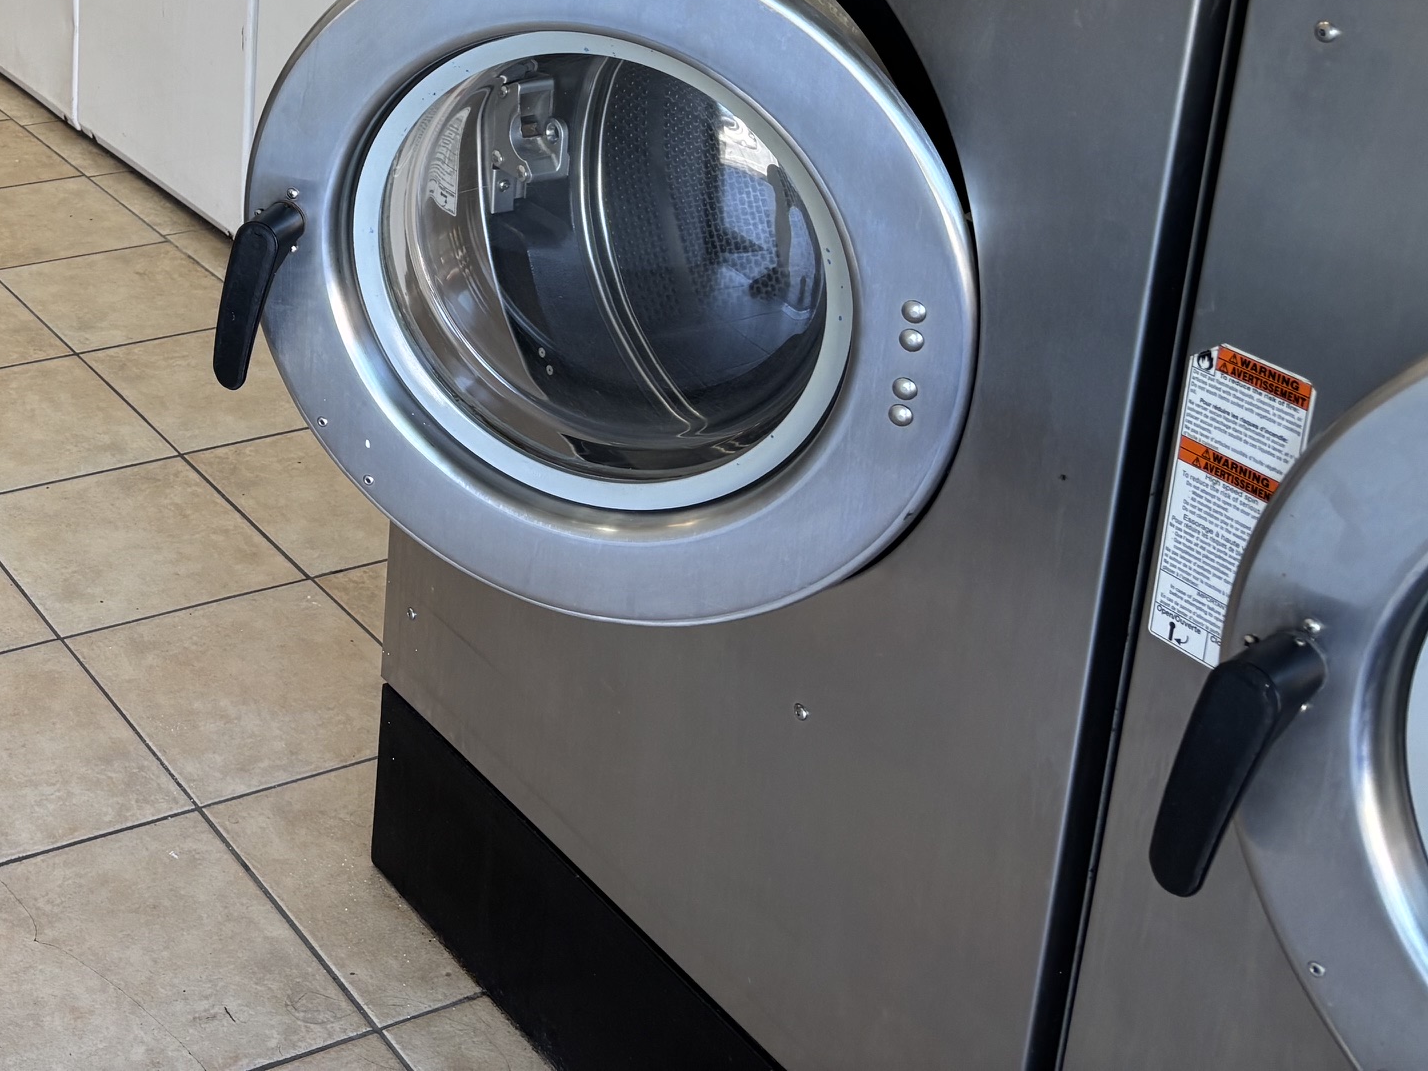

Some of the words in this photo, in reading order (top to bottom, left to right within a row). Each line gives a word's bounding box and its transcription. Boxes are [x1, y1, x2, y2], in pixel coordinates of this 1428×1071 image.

[1220, 373, 1228, 381] To
[1228, 376, 1251, 391] reduce
[1230, 367, 1307, 407] AVERTISSEMENT
[1240, 356, 1300, 392] WARNING
[1203, 461, 1271, 502] AVERTISSEMEN
[1212, 451, 1270, 489] WARNING
[1156, 604, 1202, 635] Open/Ouverte
